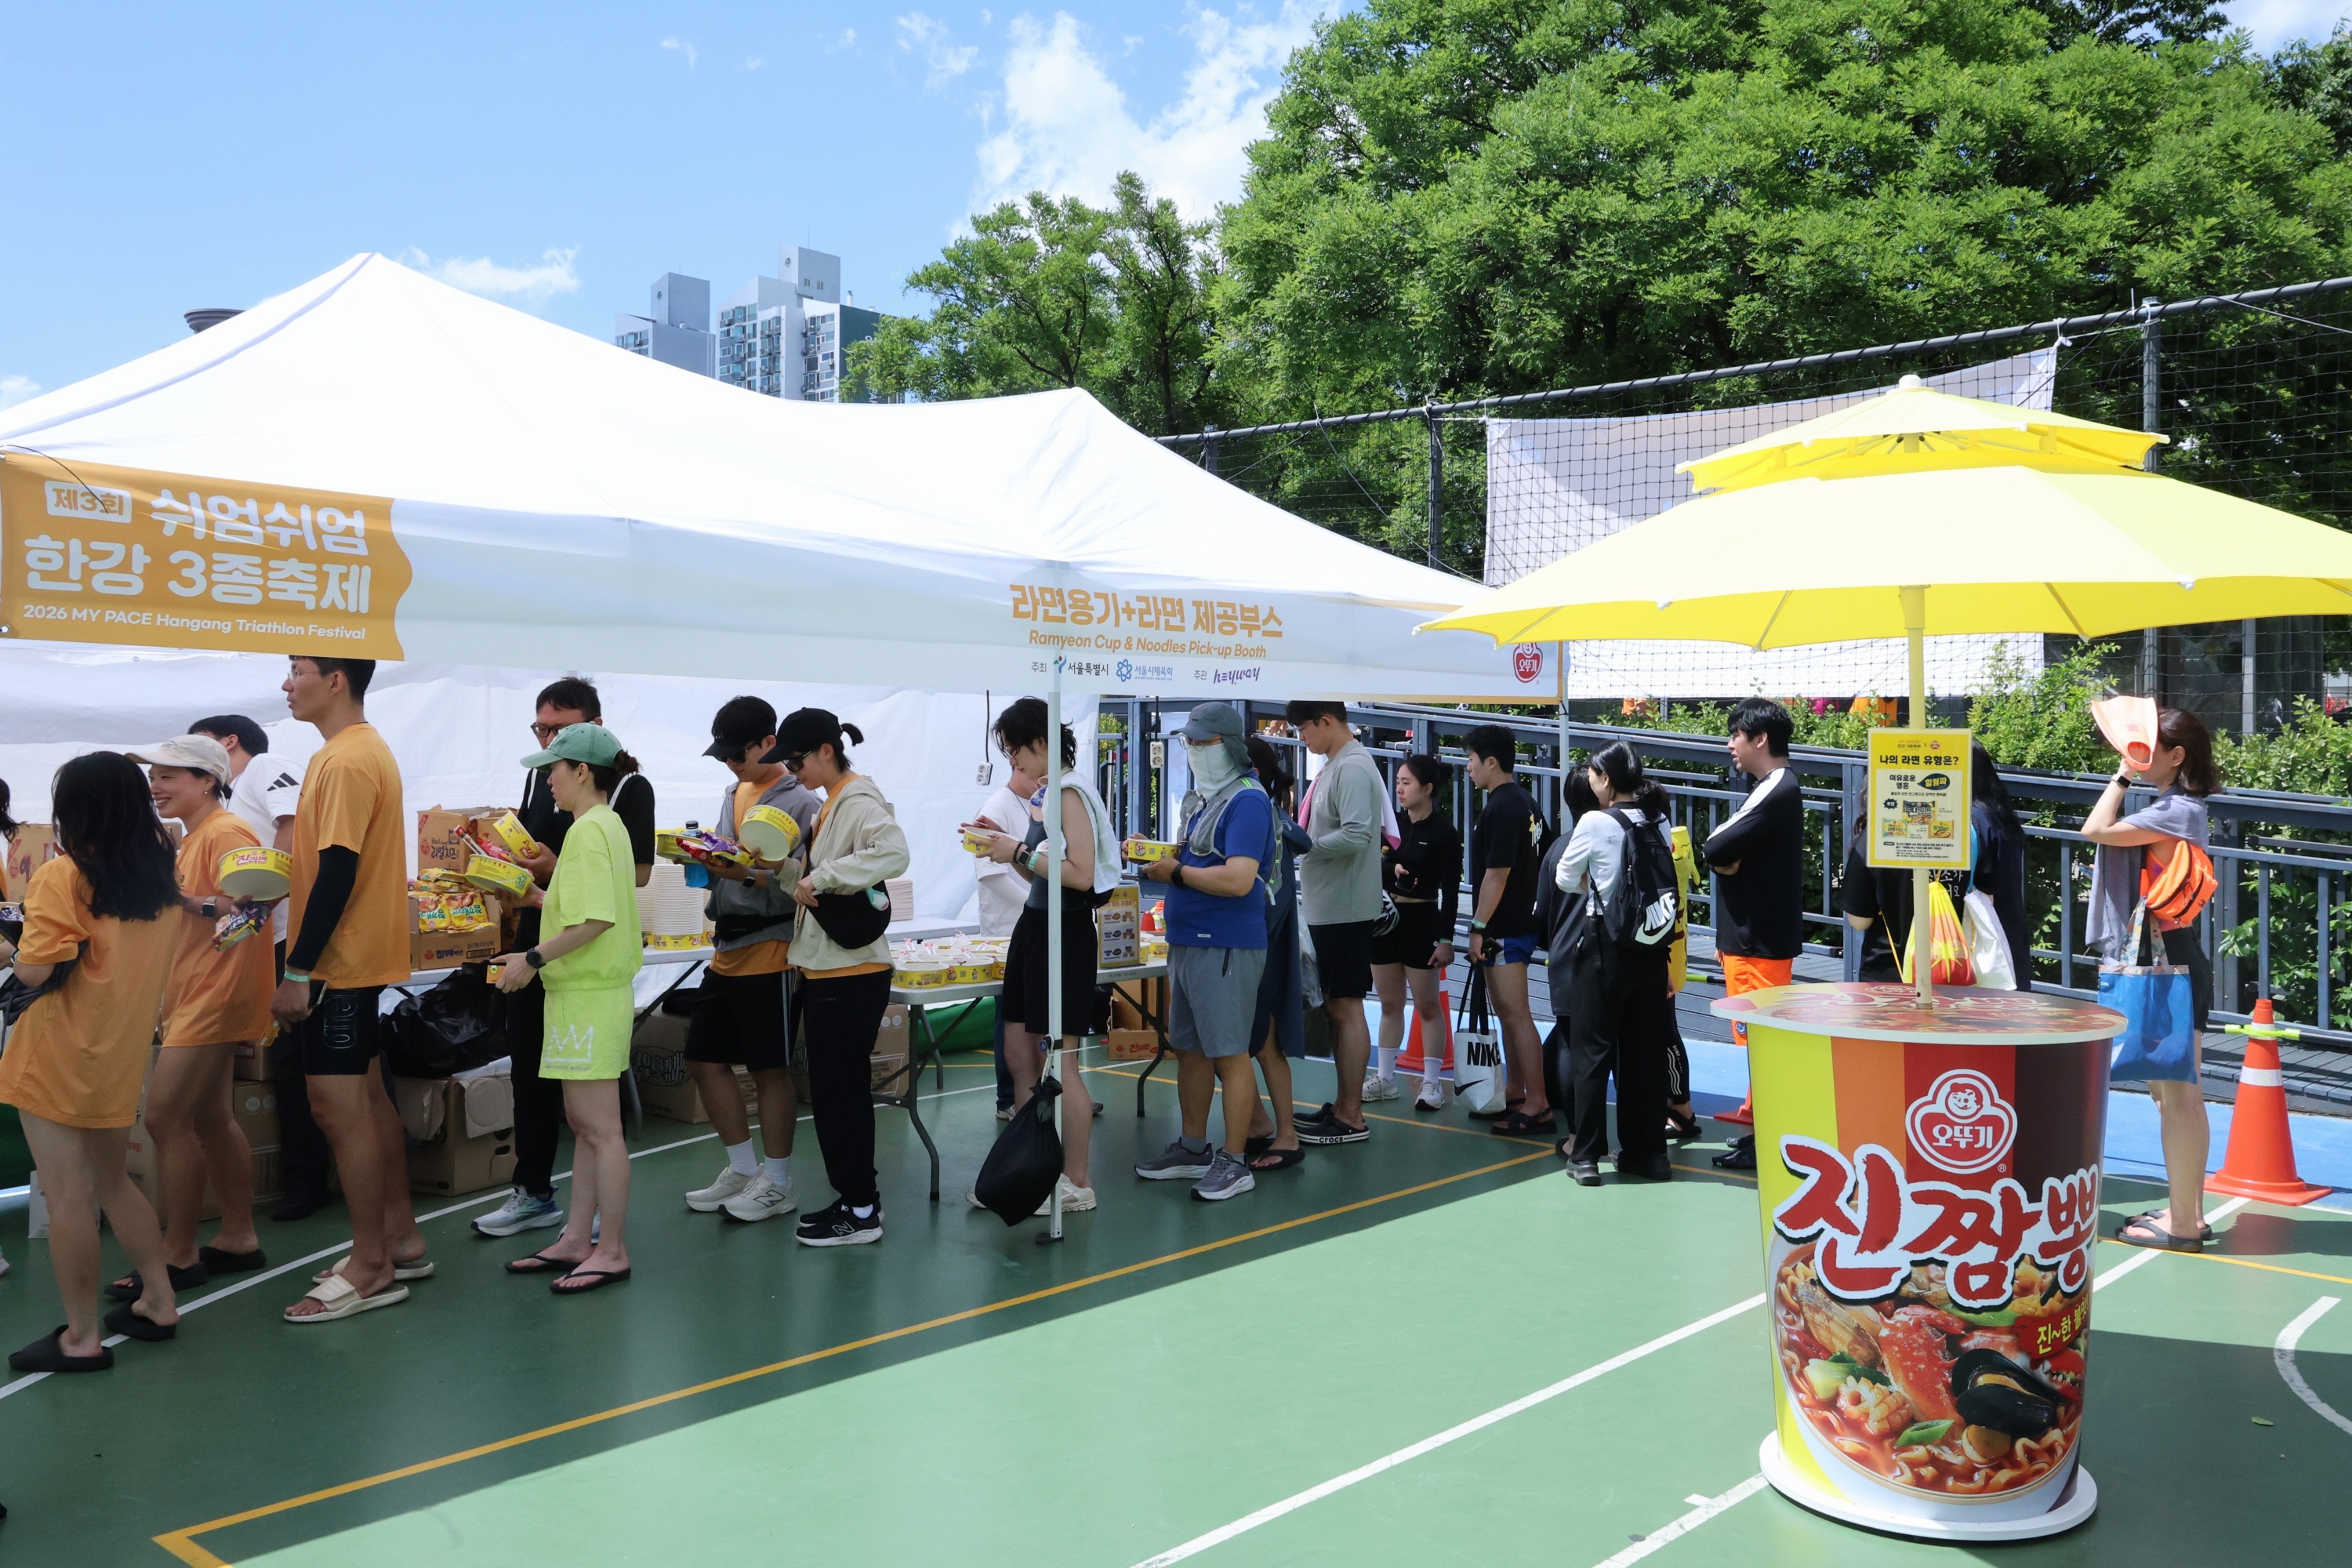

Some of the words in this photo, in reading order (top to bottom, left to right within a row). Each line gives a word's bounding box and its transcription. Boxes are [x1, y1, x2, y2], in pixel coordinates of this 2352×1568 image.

[53, 488, 124, 516] 제3회
[151, 488, 368, 556] 쉬엄쉬엄
[24, 534, 151, 596] 한강
[168, 550, 372, 614] 3종축제
[24, 604, 67, 619] 2026
[72, 608, 101, 621] MY
[105, 610, 152, 625] PACE
[157, 614, 231, 633] Hangang
[236, 619, 304, 635] Triathlon
[308, 624, 366, 639] Festival
[1010, 584, 1185, 632] 라면용기+라면
[1192, 600, 1283, 638] 제공부스
[1029, 630, 1091, 650] Ramyeon
[1094, 634, 1121, 653] Cup
[1124, 636, 1133, 650] &
[1137, 637, 1186, 654] Noodles
[1189, 641, 1232, 659] Pick-up
[1234, 644, 1266, 658] Booth
[1031, 662, 1047, 673] 주최
[1067, 662, 1109, 676] 서울특별시
[1134, 665, 1173, 677] 서울시체육회
[1194, 670, 1207, 681] 주관
[1519, 659, 1537, 673] 오뚜기
[1879, 755, 1898, 765] 나의
[1901, 755, 1920, 765] 라면
[1923, 755, 1958, 766] 유형은?
[1925, 777, 1947, 787] 힐링파
[1933, 1123, 1994, 1149] 오뚜기
[1775, 1141, 2097, 1303] 진짬뽕
[2037, 1315, 2071, 1355] 진~한
